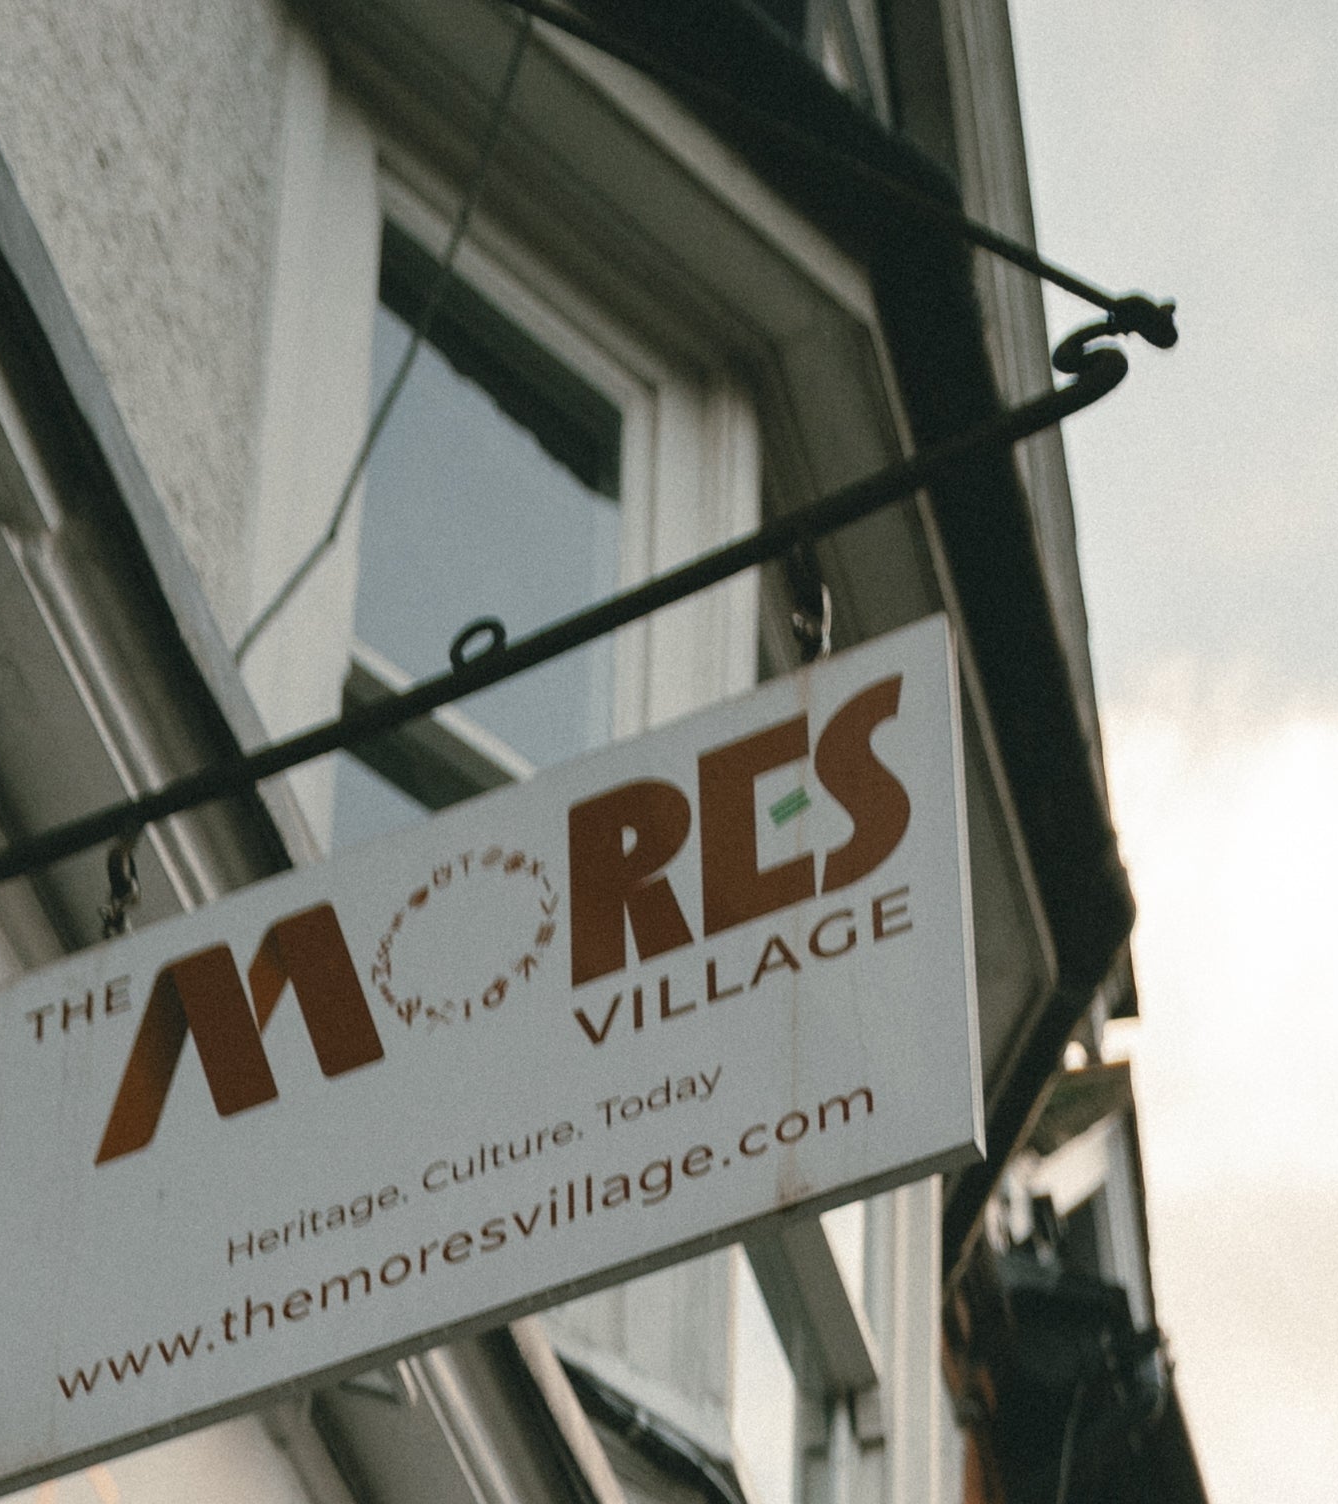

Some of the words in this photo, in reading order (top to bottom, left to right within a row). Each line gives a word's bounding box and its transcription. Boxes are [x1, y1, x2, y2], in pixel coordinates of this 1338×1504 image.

[24, 974, 132, 1046] THE
[573, 884, 915, 1048] VILLAGE
[56, 1080, 877, 1402] www.themoresvillage.com
[225, 1183, 411, 1267] Heritage.
[594, 1063, 725, 1134] Today
